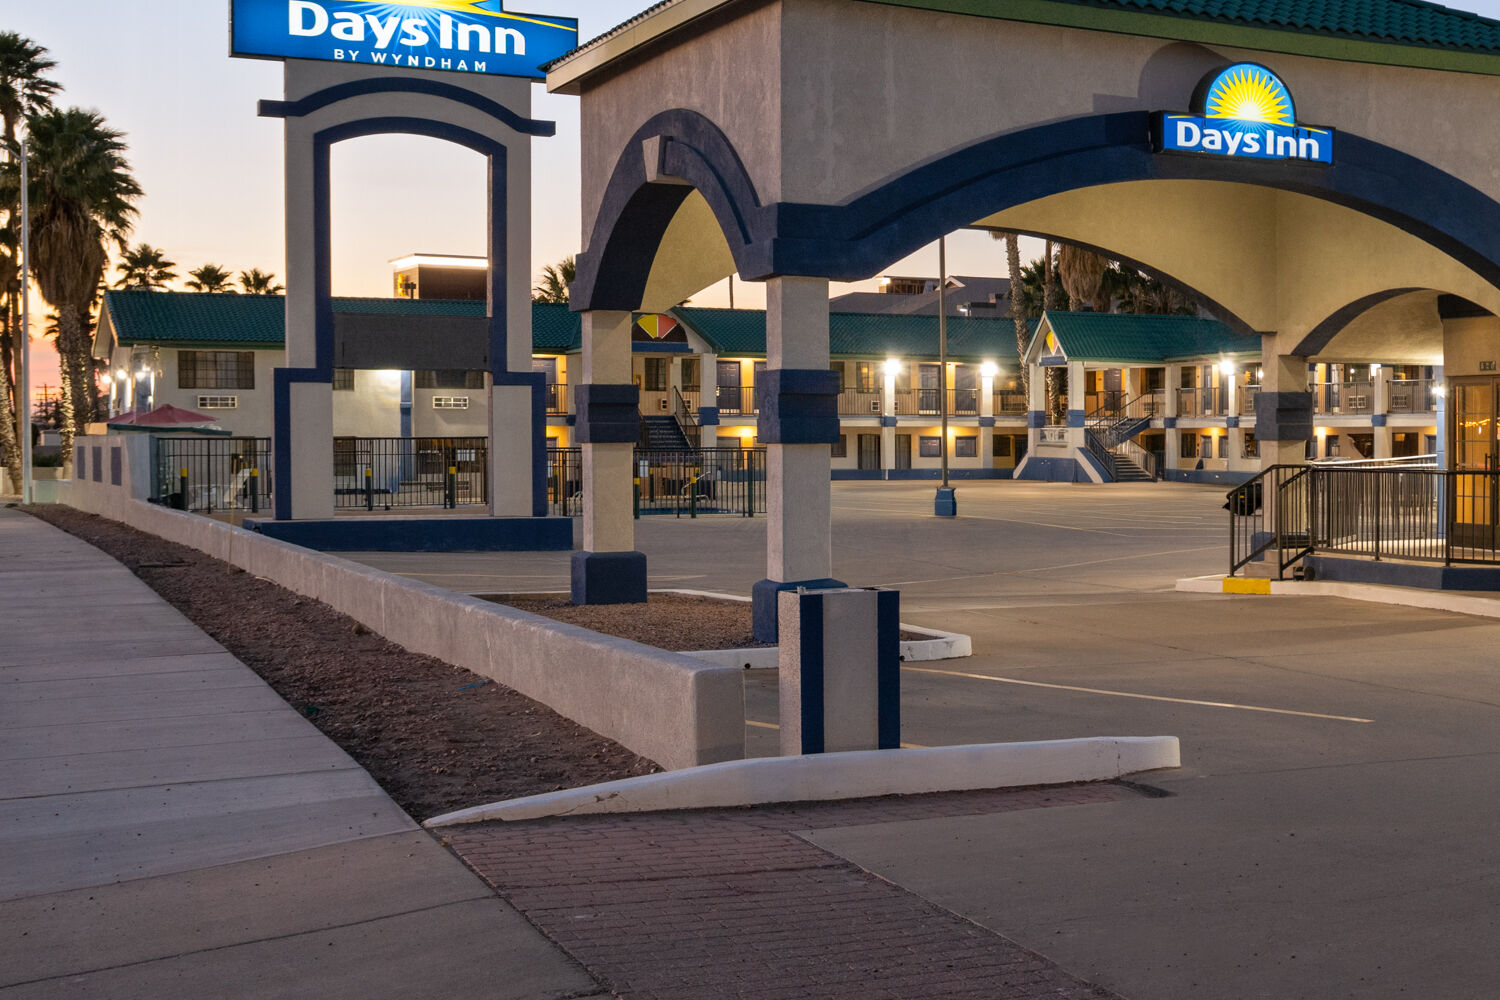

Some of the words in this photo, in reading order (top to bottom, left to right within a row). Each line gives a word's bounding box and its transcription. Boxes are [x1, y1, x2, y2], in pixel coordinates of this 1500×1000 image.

[288, 0, 428, 49] Days
[439, 12, 526, 56] Inn
[334, 48, 359, 61] BY
[371, 51, 487, 72] WYNDHAM
[1176, 120, 1261, 155] Days
[1266, 129, 1320, 159] Inn
